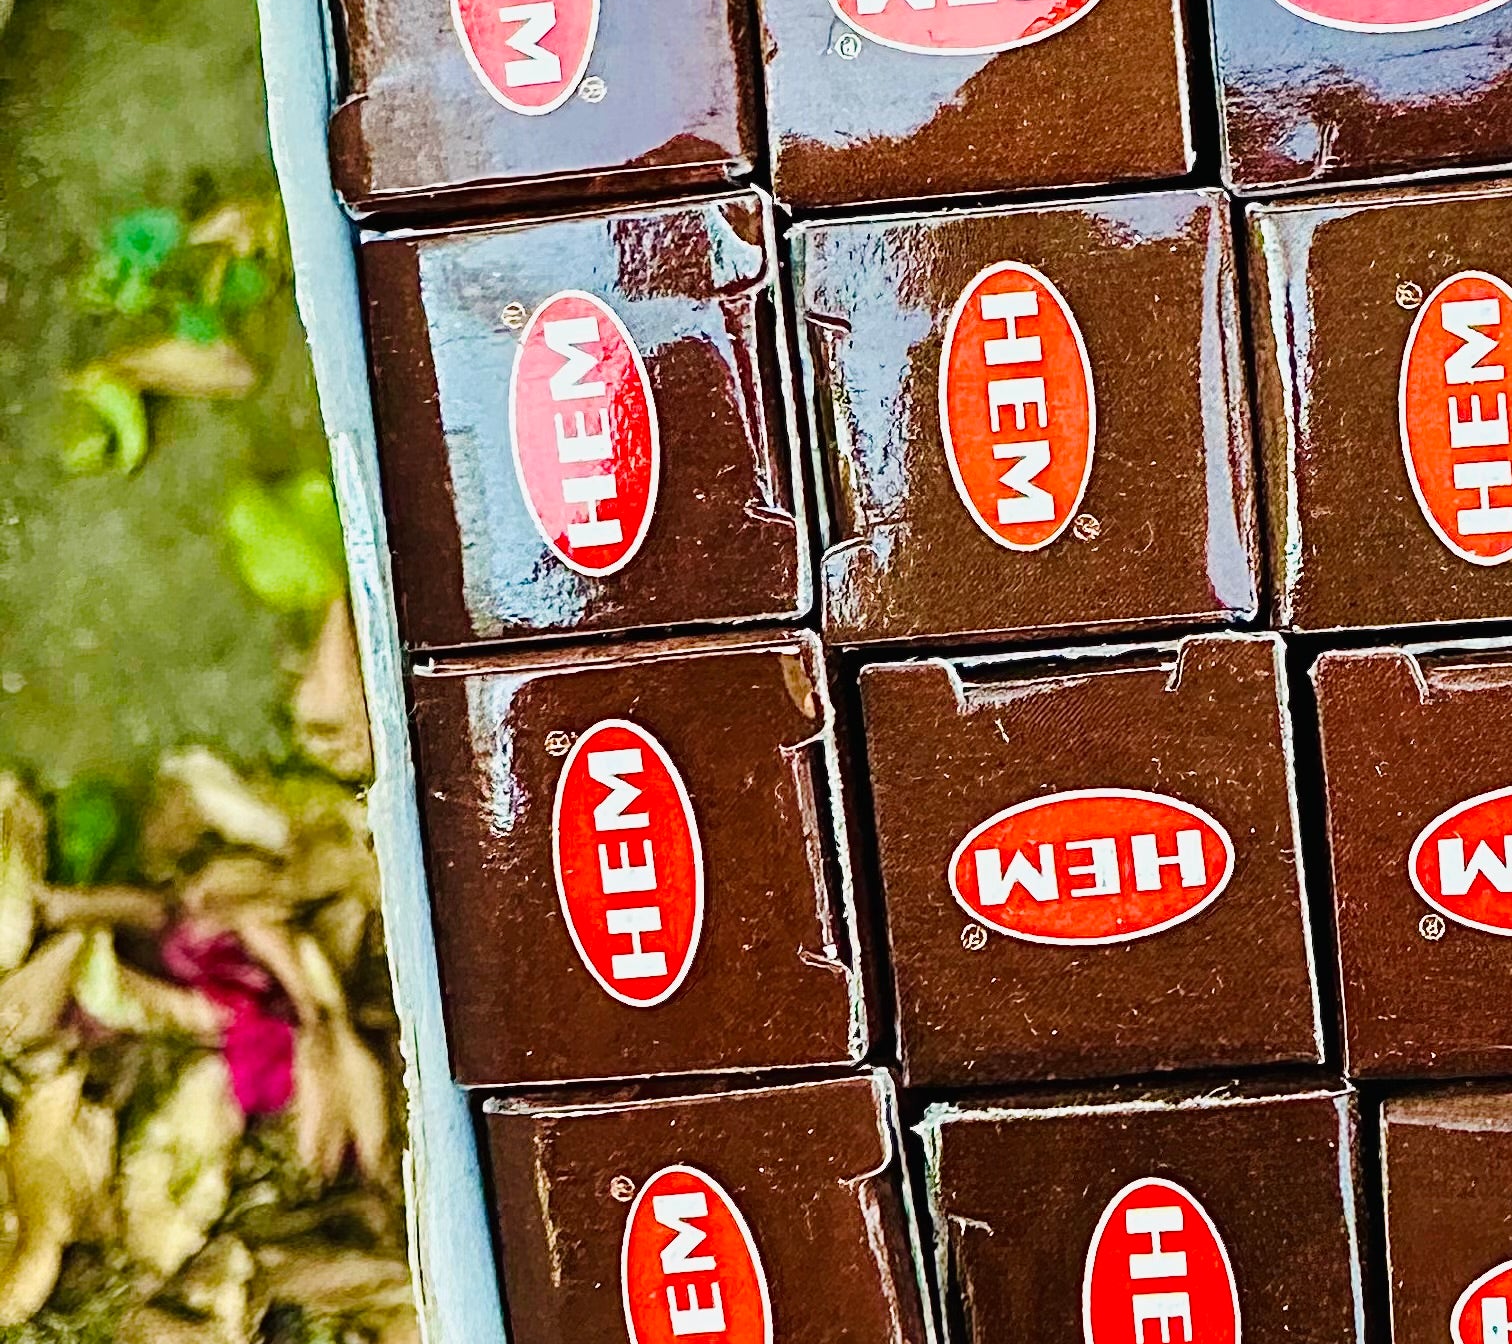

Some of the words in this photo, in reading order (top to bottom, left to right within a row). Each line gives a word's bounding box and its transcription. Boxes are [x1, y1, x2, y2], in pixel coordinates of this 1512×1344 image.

[544, 317, 622, 547] HEM
[982, 292, 1054, 523] HEM
[589, 749, 667, 978] HEM
[976, 830, 1205, 905] HEM
